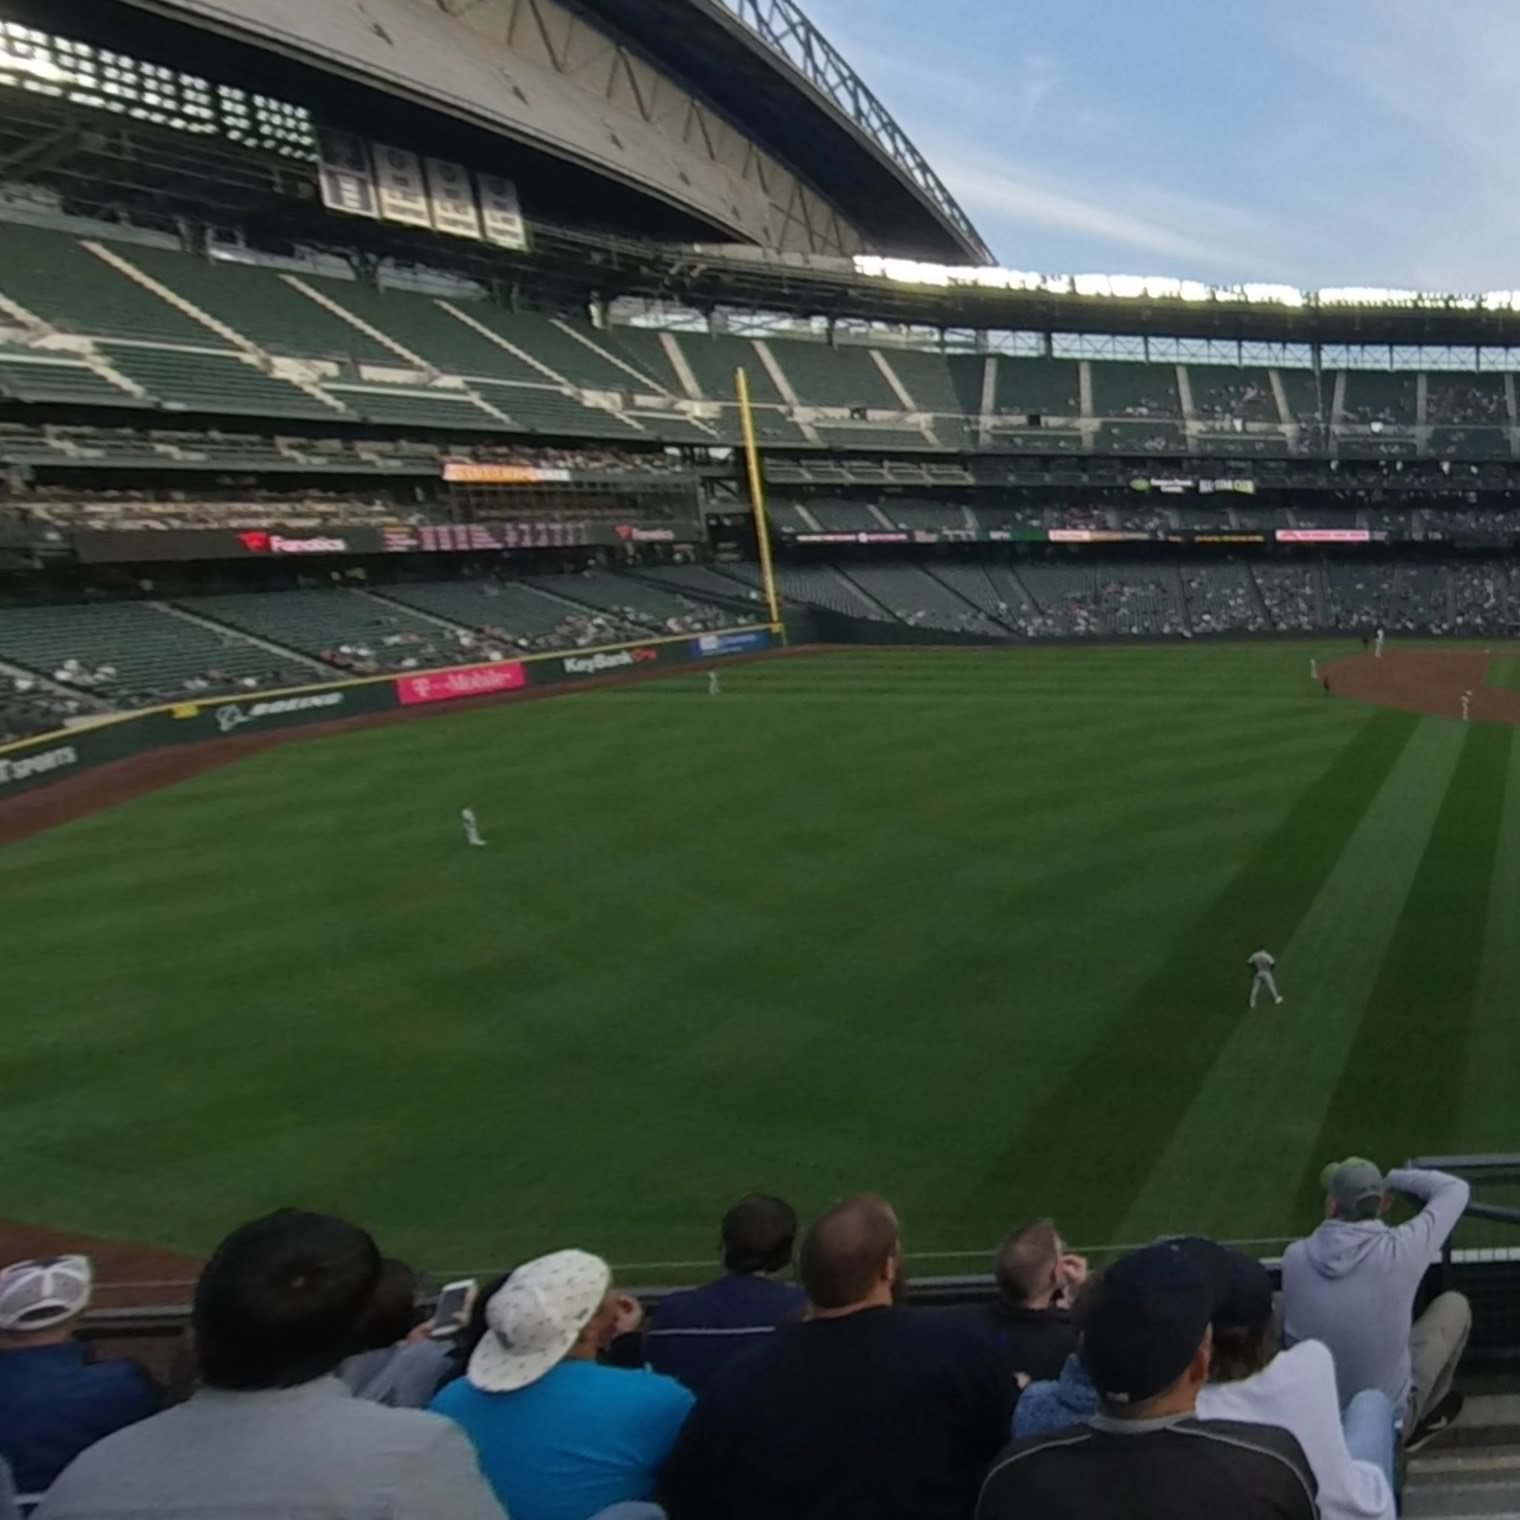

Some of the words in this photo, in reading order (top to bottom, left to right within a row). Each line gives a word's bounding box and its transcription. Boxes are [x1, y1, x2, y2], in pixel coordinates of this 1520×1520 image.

[269, 535, 346, 553] Fanatics
[563, 651, 634, 674] KeyBank
[248, 691, 344, 716] BOEING
[13, 746, 77, 779] SPORTS
